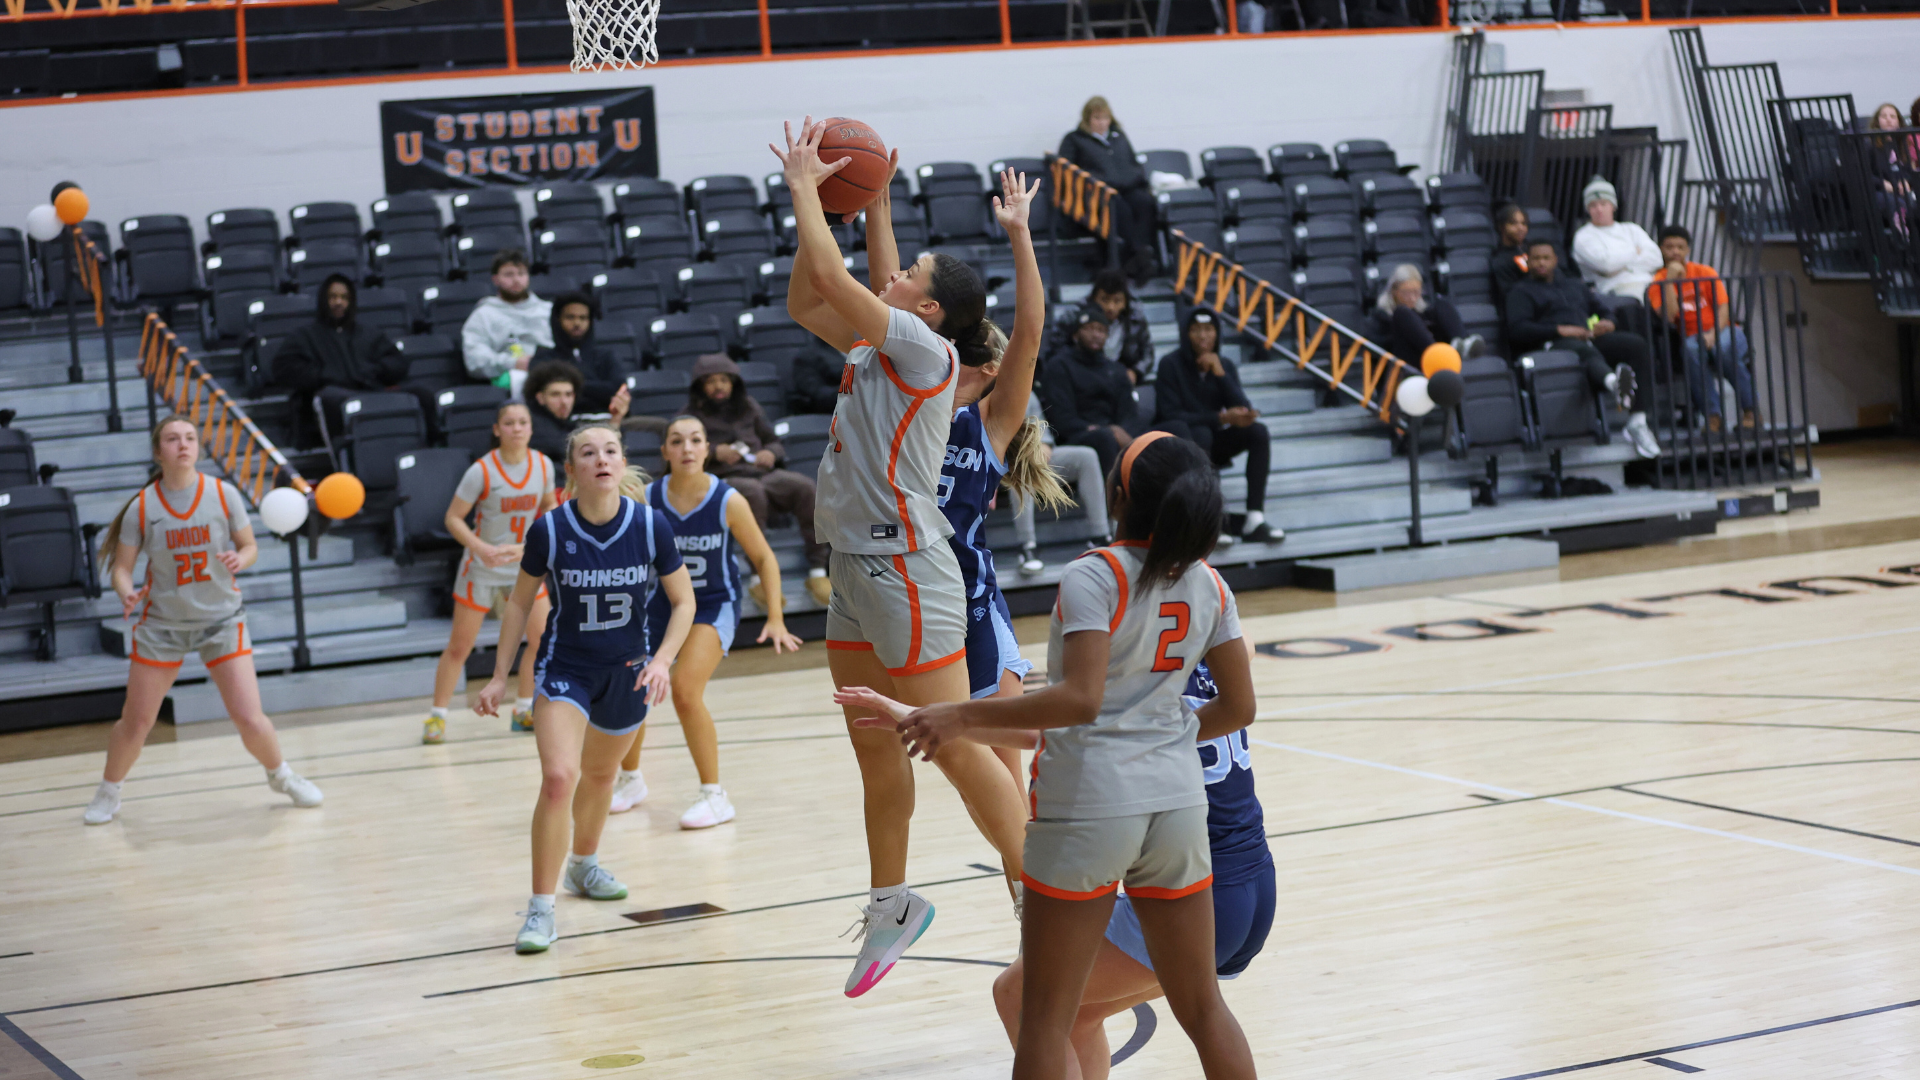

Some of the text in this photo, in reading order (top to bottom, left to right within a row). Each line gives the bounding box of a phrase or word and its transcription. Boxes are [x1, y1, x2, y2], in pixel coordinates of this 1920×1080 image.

[434, 105, 604, 142] STUDENT
[613, 118, 641, 151] U
[394, 131, 423, 165] U
[444, 140, 600, 177] SECTION
[165, 524, 211, 549] UNION
[510, 516, 526, 543] 4
[676, 533, 722, 551] NSON
[174, 550, 211, 586] 22
[560, 563, 648, 588] JOHNSON
[579, 592, 633, 631] 13
[1150, 600, 1191, 672] 2
